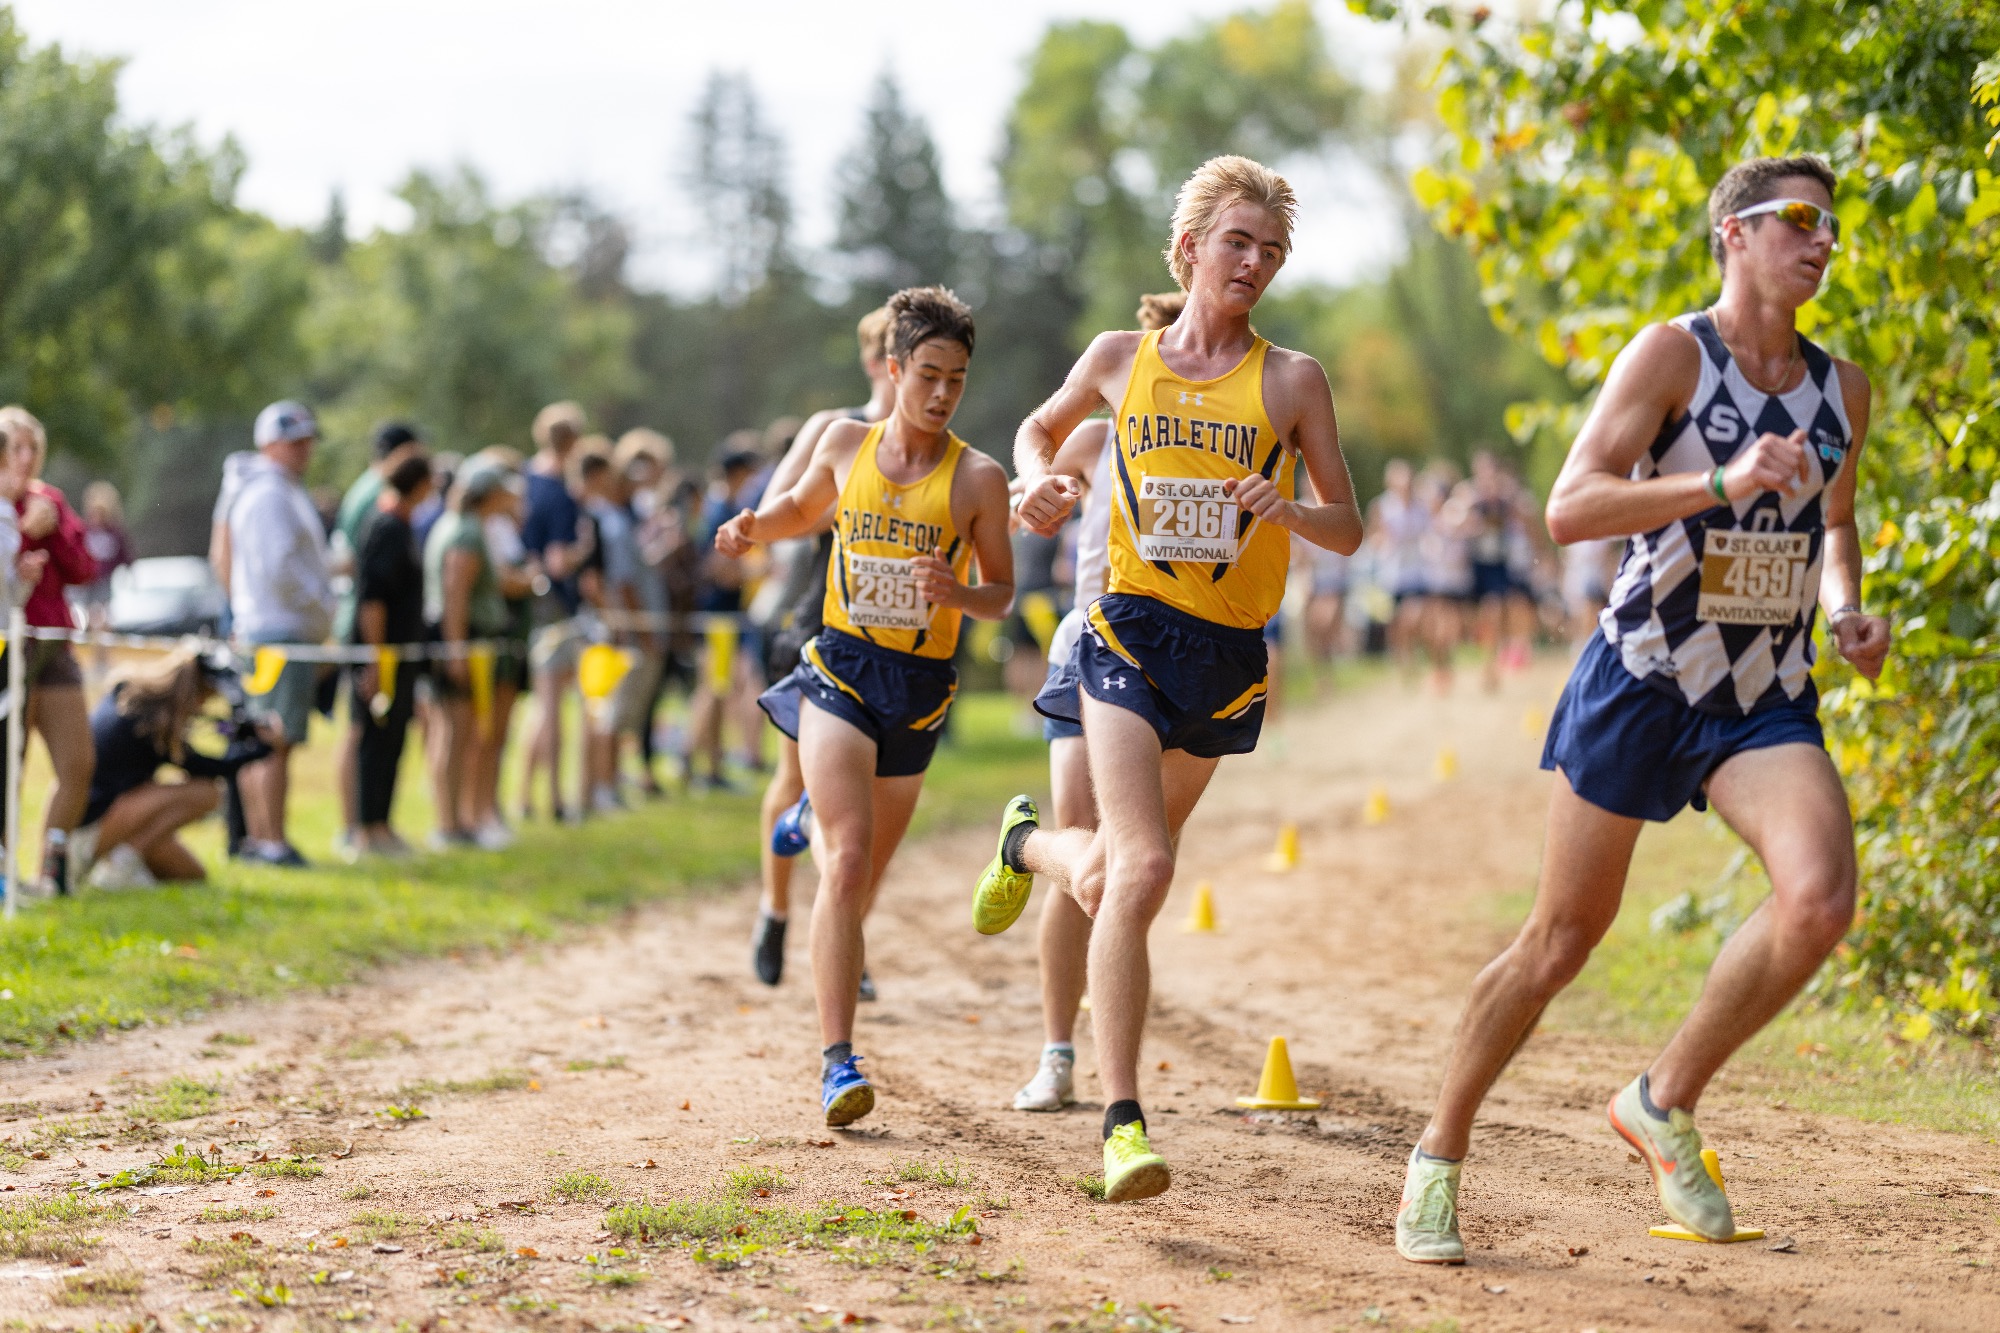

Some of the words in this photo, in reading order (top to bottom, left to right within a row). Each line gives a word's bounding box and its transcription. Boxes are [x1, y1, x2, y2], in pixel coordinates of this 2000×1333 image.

[1704, 404, 1739, 443] S
[1128, 413, 1258, 471] CARLETON
[1156, 483, 1177, 497] ST.
[1179, 483, 1220, 498] OLAF
[1152, 499, 1221, 538] 296
[1144, 544, 1230, 560] NVITATIONAL
[1754, 538, 1791, 554] OLAF
[855, 575, 913, 610] 285
[1722, 556, 1791, 598] 459
[849, 612, 920, 627] NVITATIONAL
